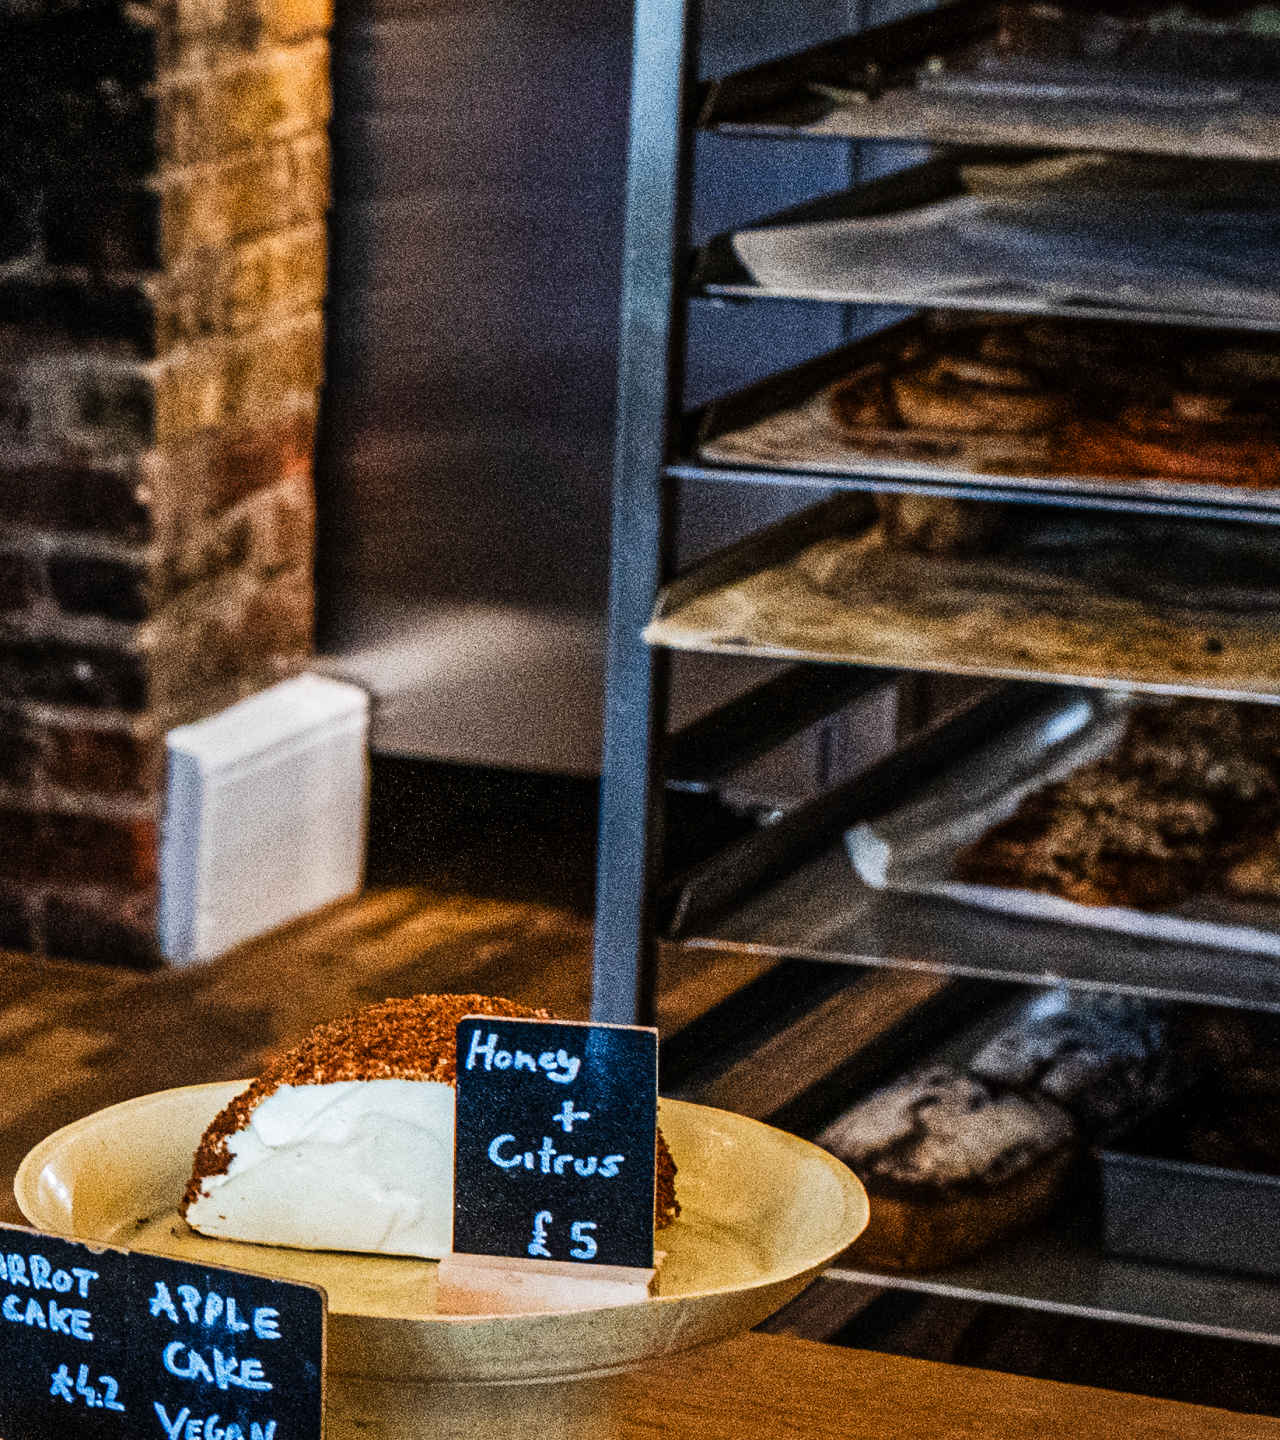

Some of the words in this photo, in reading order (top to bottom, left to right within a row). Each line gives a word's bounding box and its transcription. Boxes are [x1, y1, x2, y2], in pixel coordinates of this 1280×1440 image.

[465, 1029, 581, 1084] Honey
[552, 1100, 590, 1133] +
[488, 1133, 625, 1178] Citrus
[2, 1294, 93, 1341] CAKE
[149, 1281, 282, 1340] APPLE
[162, 1341, 273, 1390] CAKE
